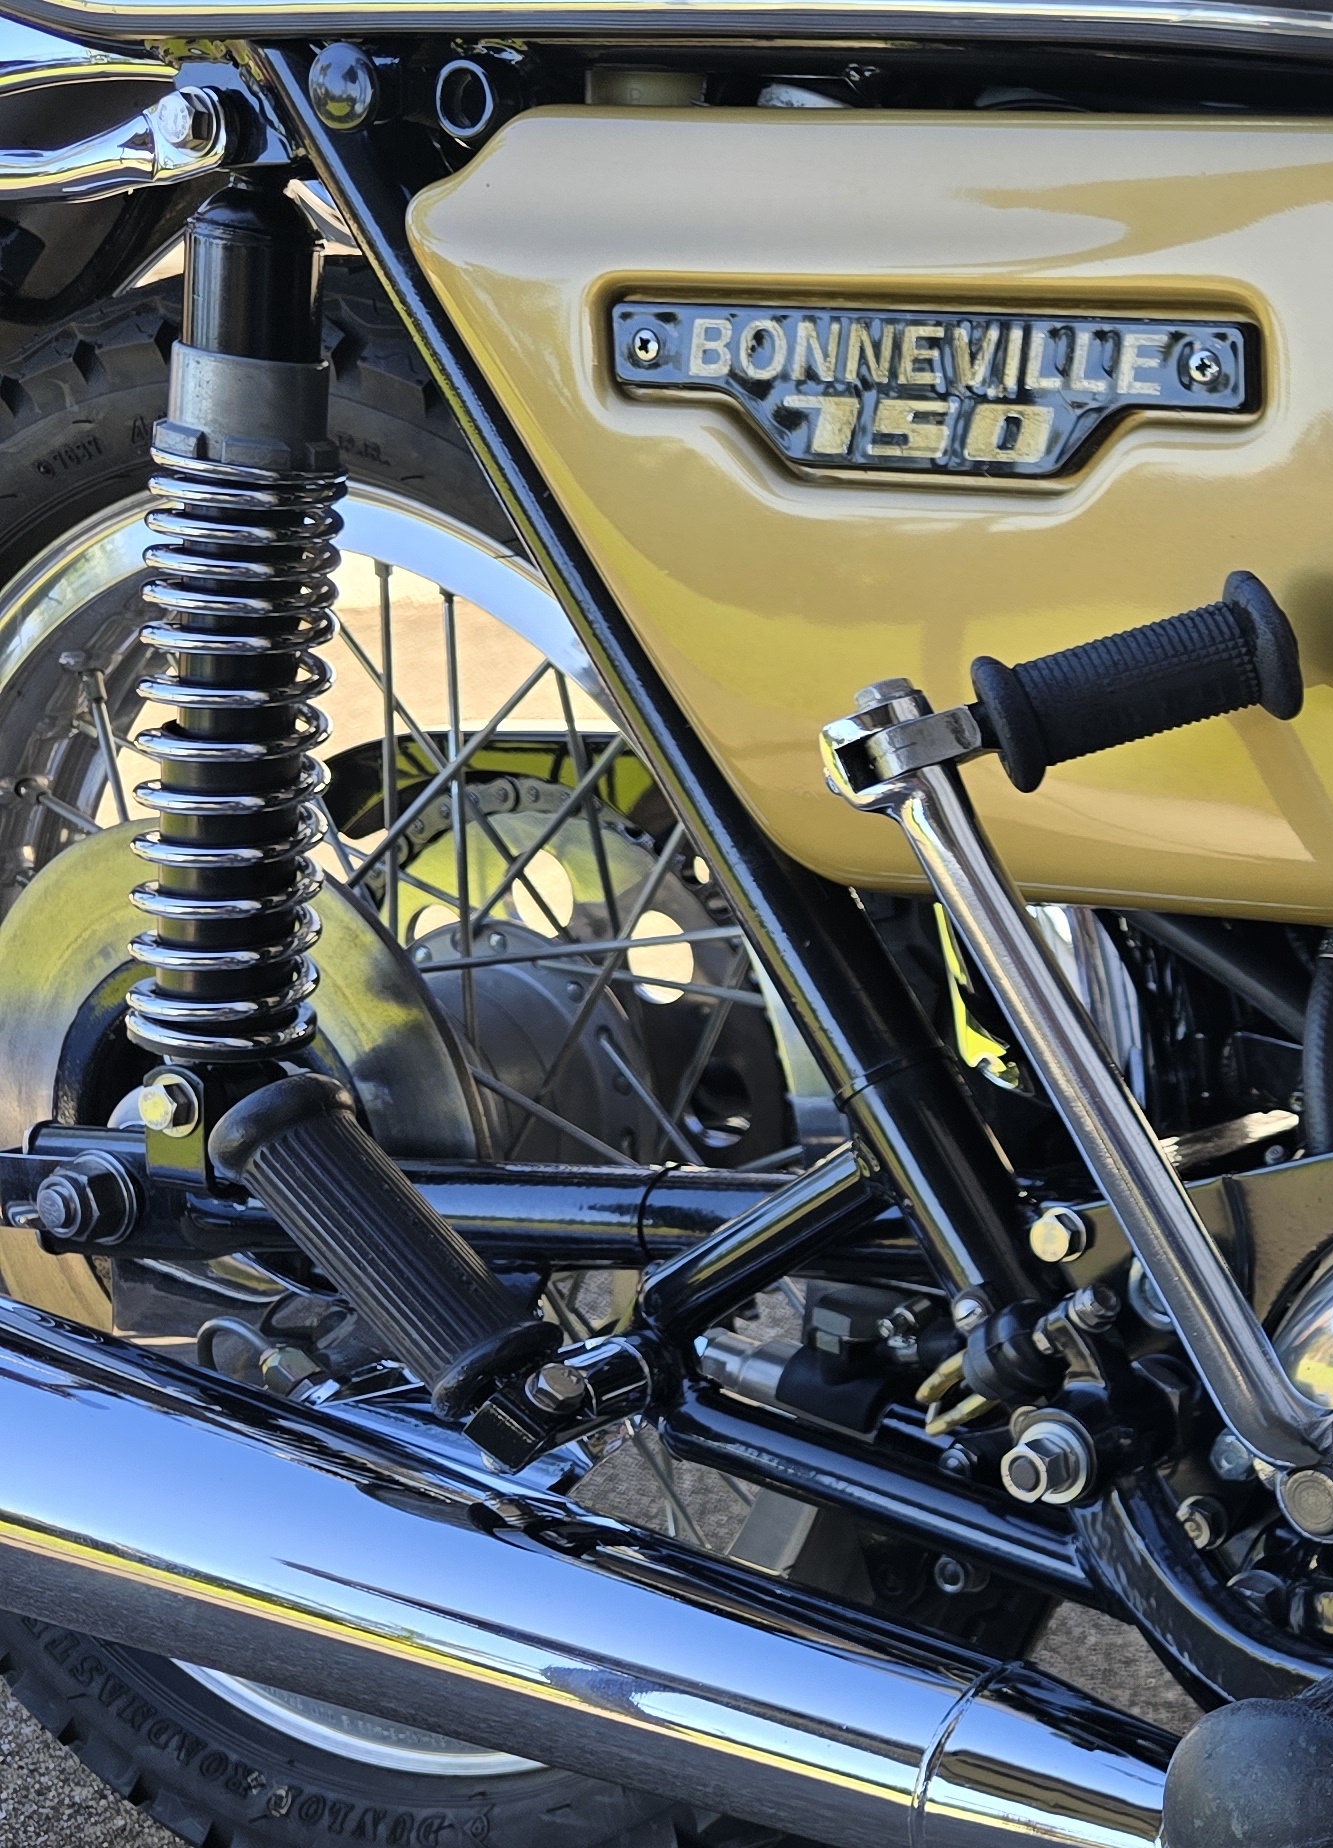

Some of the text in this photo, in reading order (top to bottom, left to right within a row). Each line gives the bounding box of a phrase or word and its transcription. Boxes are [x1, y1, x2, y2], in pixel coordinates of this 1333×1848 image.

[687, 317, 1168, 397] BONNEVILLE
[782, 396, 1055, 463] 750
[21, 1614, 268, 1798] ROADMASTE
